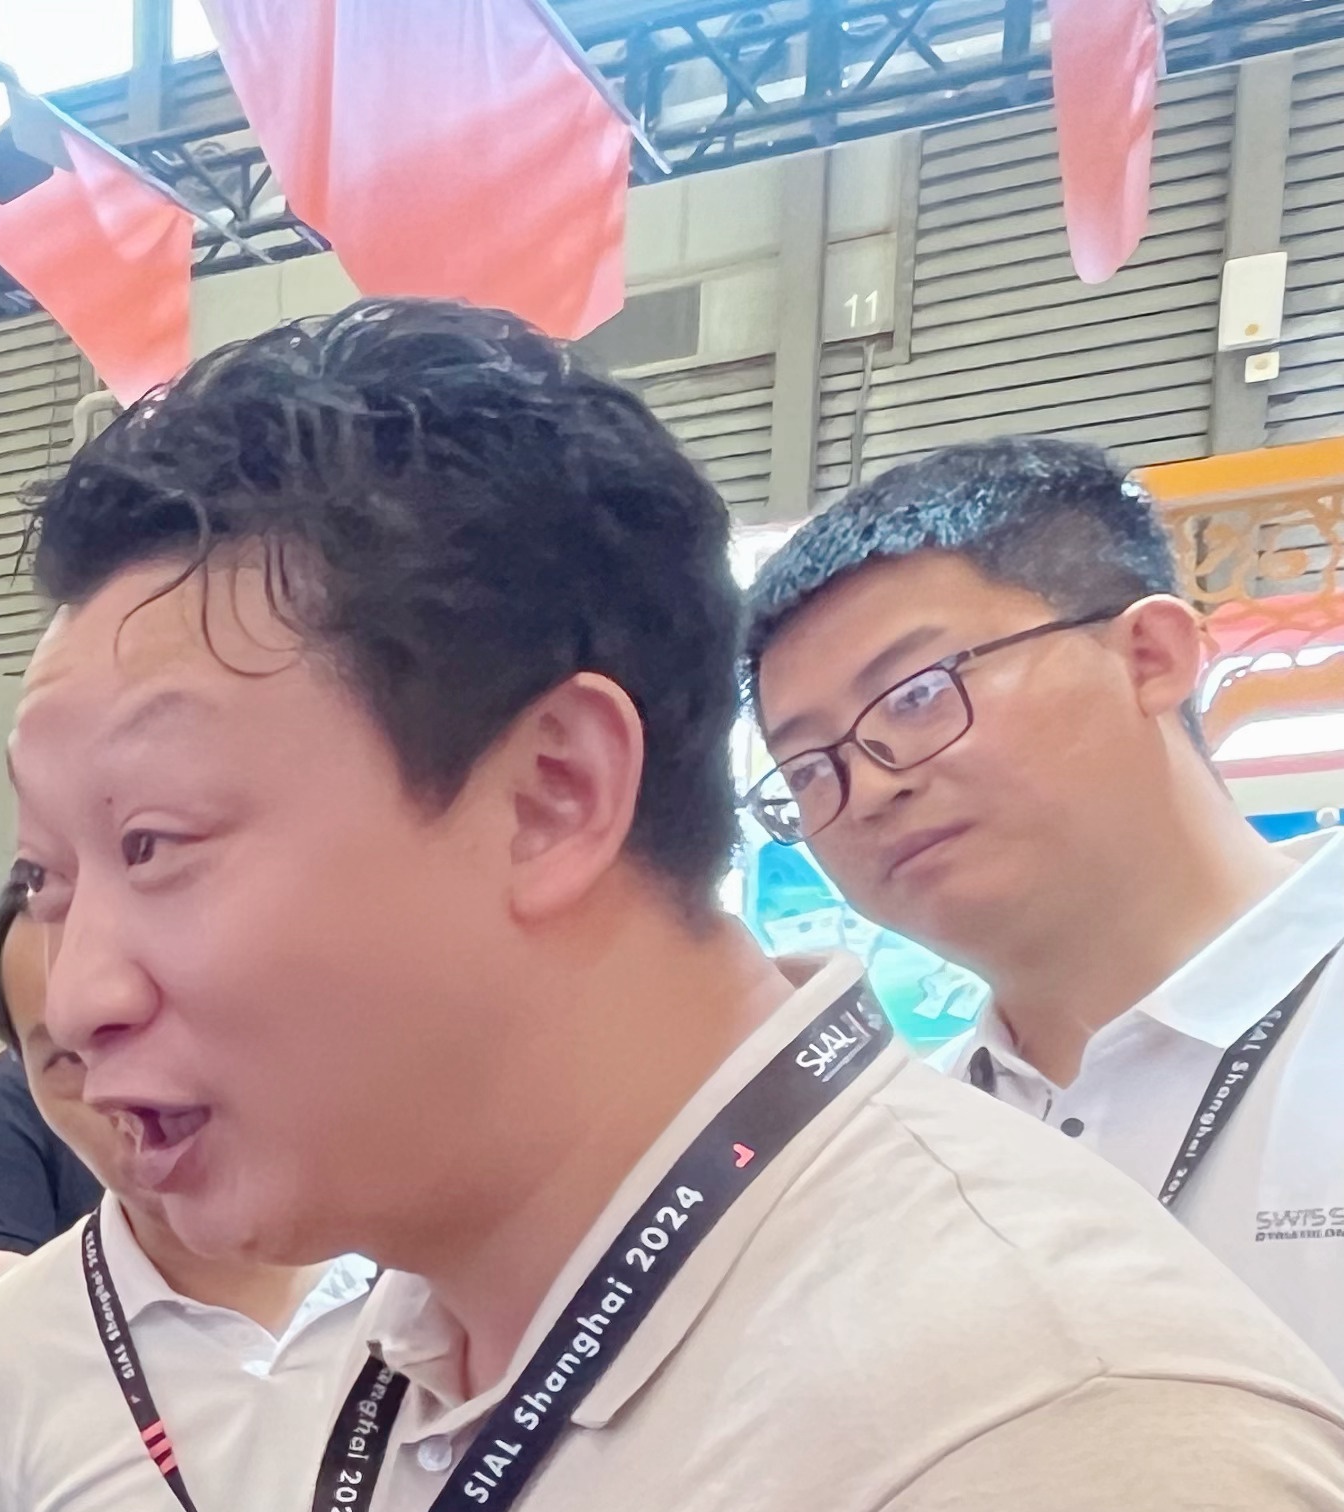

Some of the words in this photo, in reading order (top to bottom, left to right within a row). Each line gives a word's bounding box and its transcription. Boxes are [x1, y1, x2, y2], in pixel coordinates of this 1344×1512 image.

[844, 289, 878, 328] 11
[796, 1024, 857, 1077] SIAL
[1185, 1060, 1250, 1159] Shanghai
[463, 1438, 522, 1504] SIAL
[514, 1276, 634, 1431] Shanghai
[624, 1184, 704, 1273] 2024
